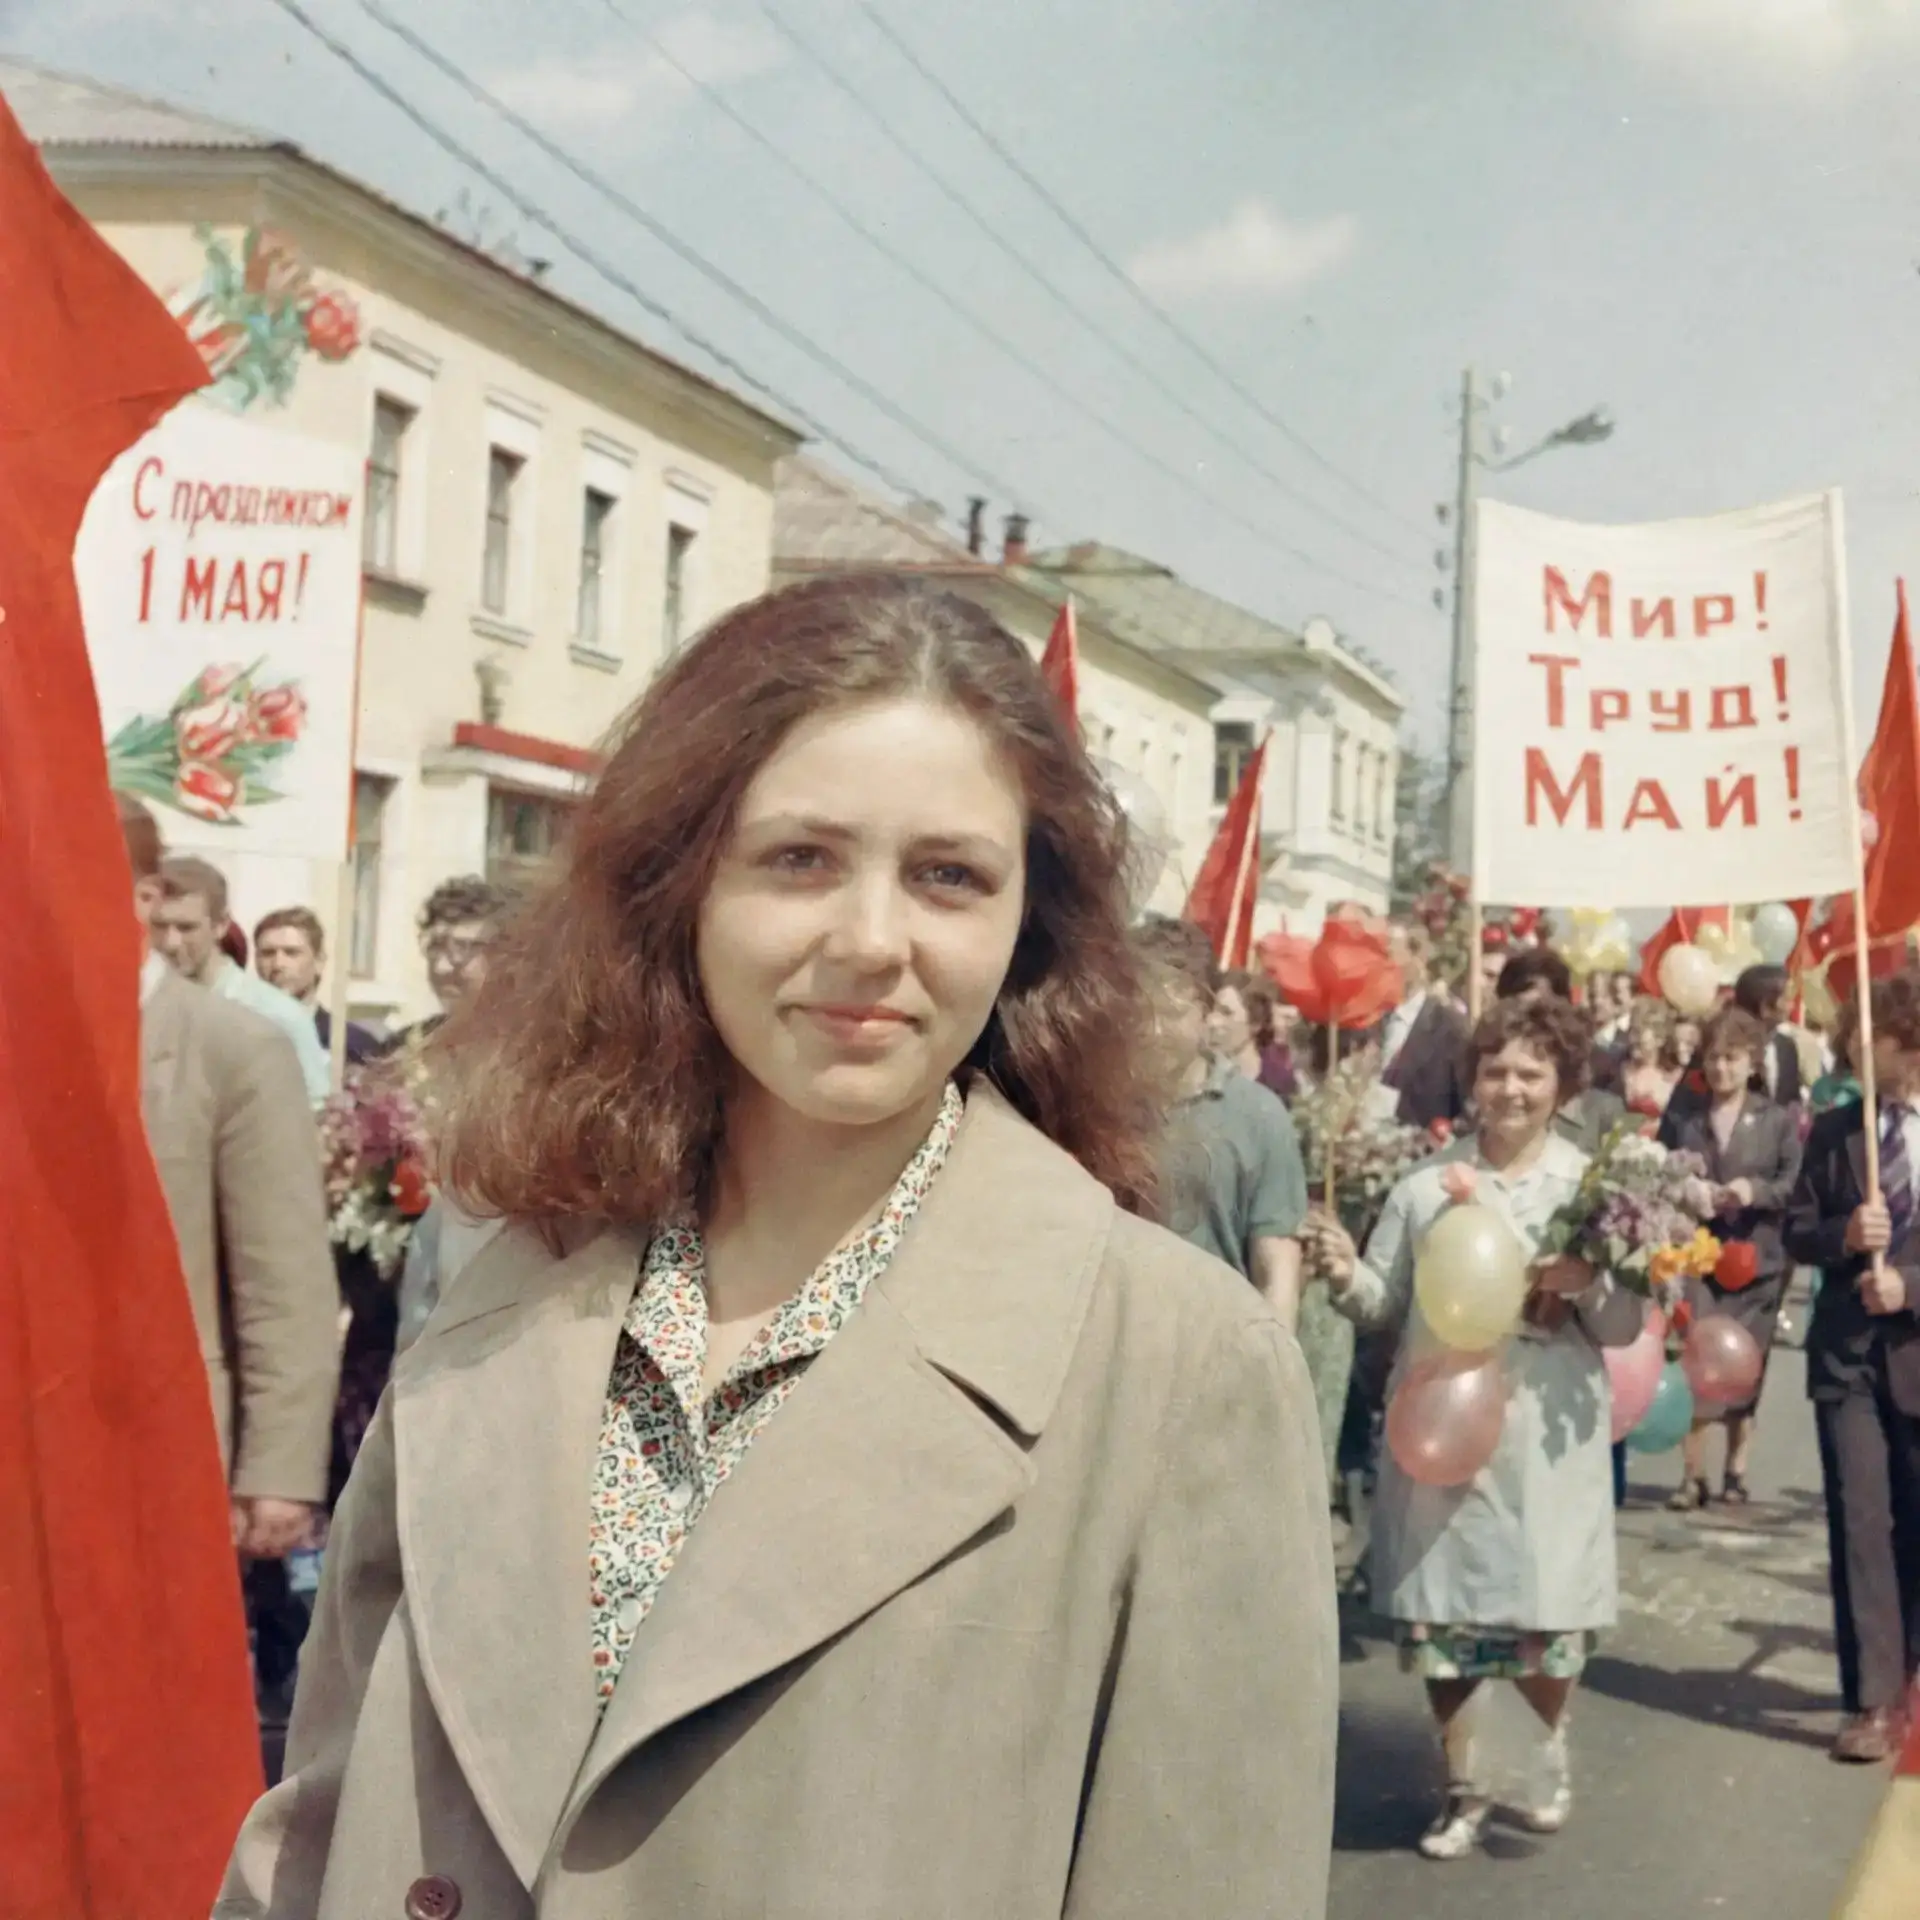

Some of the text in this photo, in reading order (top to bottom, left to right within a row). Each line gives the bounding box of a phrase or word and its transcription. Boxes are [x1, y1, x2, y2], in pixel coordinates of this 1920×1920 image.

[133, 456, 163, 520] С
[139, 546, 310, 622] 1 МАЯ!
